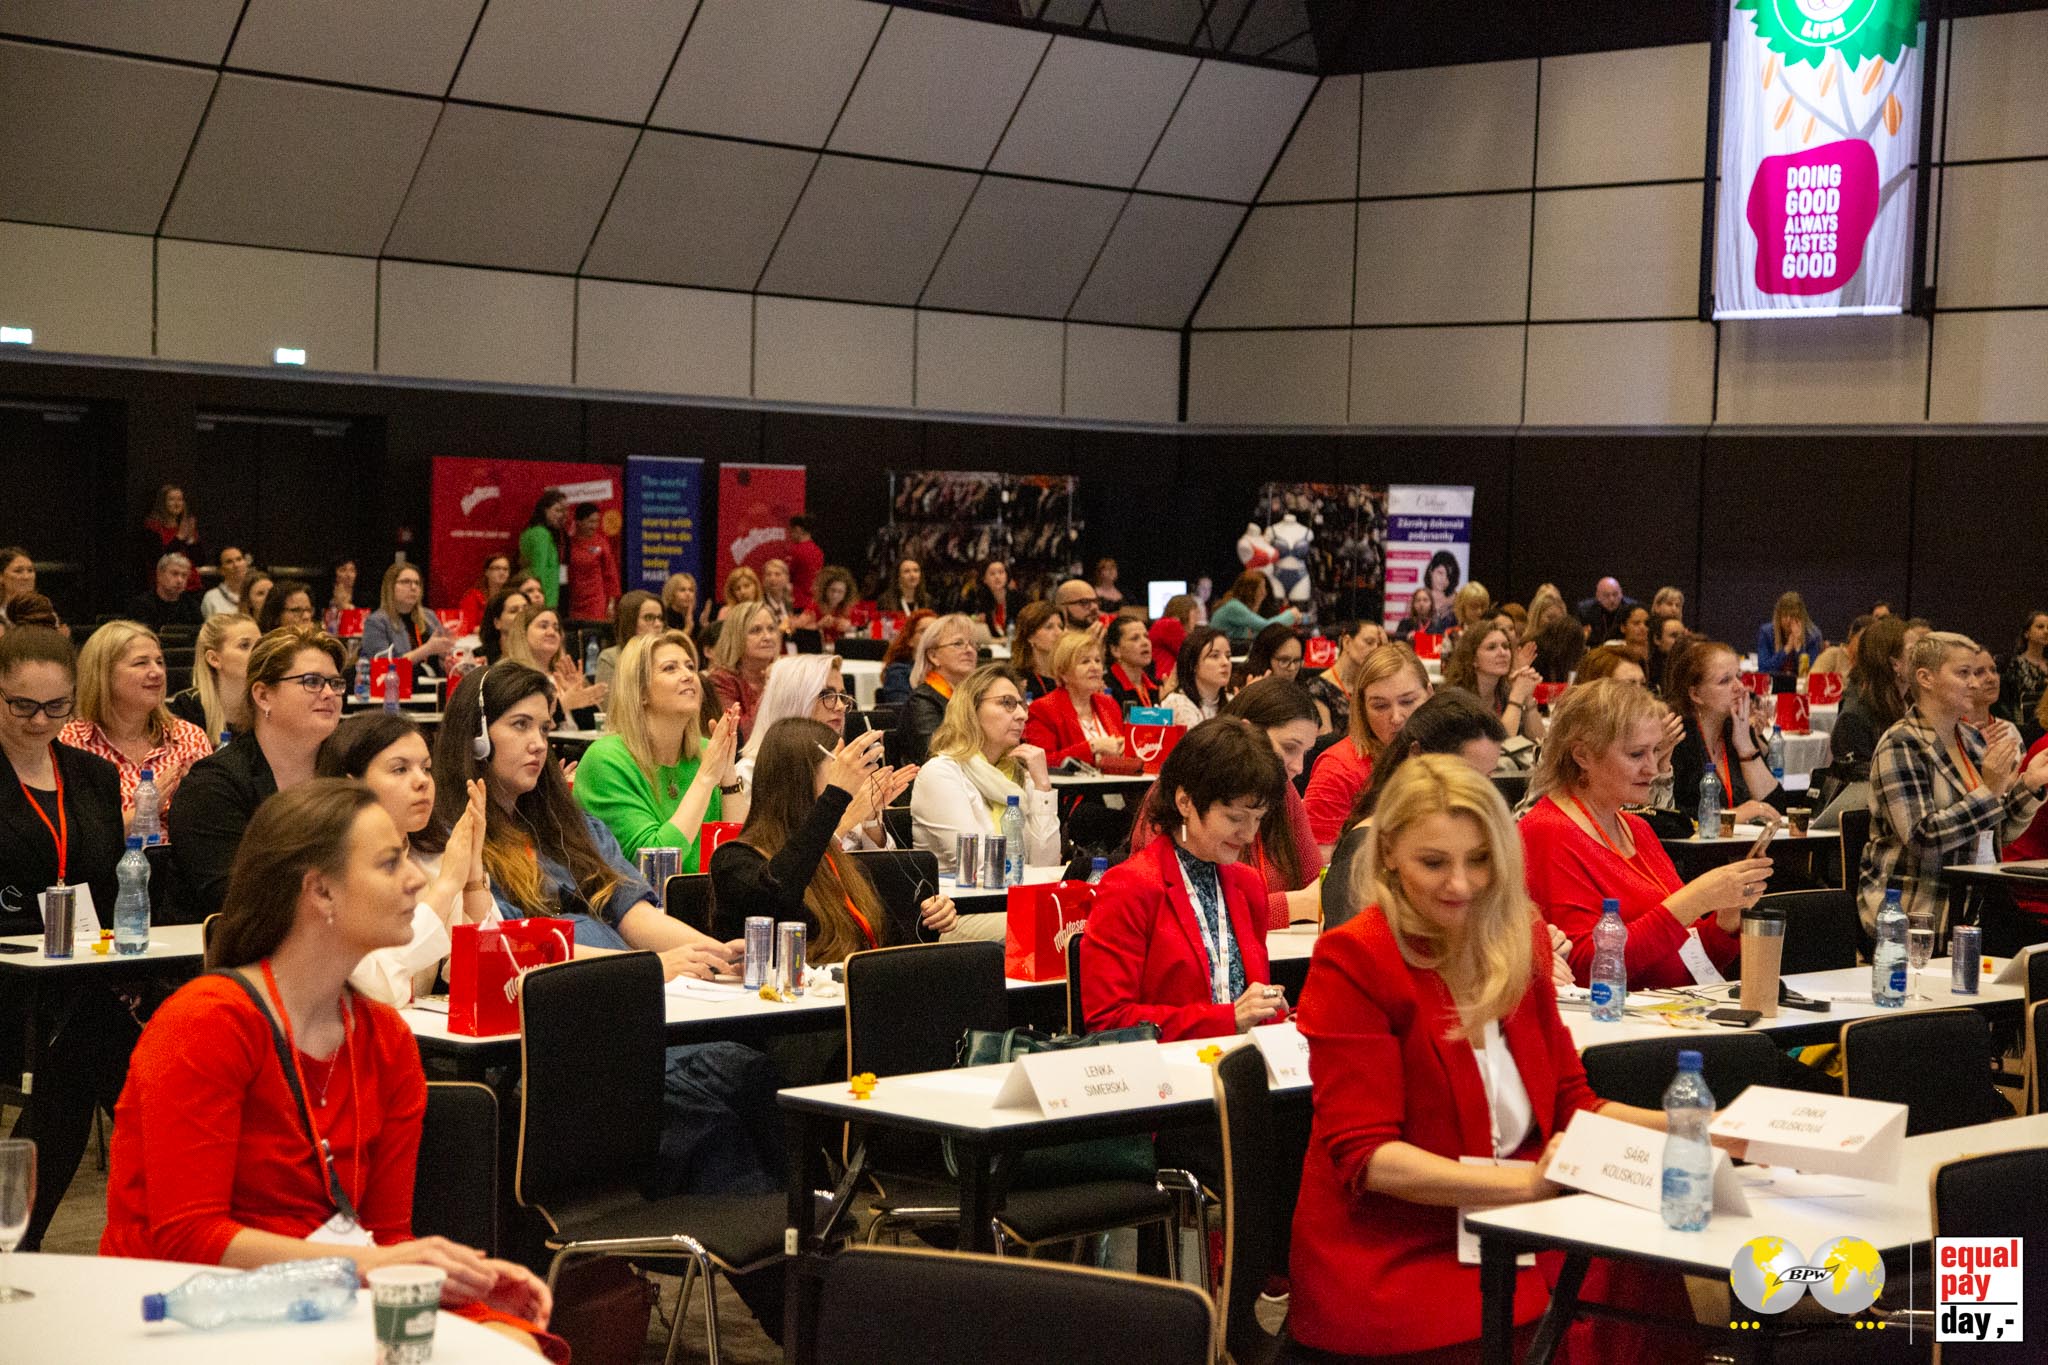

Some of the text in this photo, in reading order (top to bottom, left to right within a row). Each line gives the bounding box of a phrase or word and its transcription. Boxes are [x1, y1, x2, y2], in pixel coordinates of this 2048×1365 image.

[1801, 16, 1846, 39] LIFE
[1787, 164, 1842, 189] DOING
[1785, 188, 1840, 216] GOOD
[1784, 214, 1838, 234] ALWAYS
[1784, 233, 1837, 253] TASTES
[1782, 252, 1837, 279] GOOD
[1084, 1064, 1114, 1078] LENKA
[1084, 1081, 1130, 1097] SIMERSKÁ
[1623, 1144, 1652, 1166] SÁRA
[1601, 1163, 1656, 1190] KOUSKOVÁ
